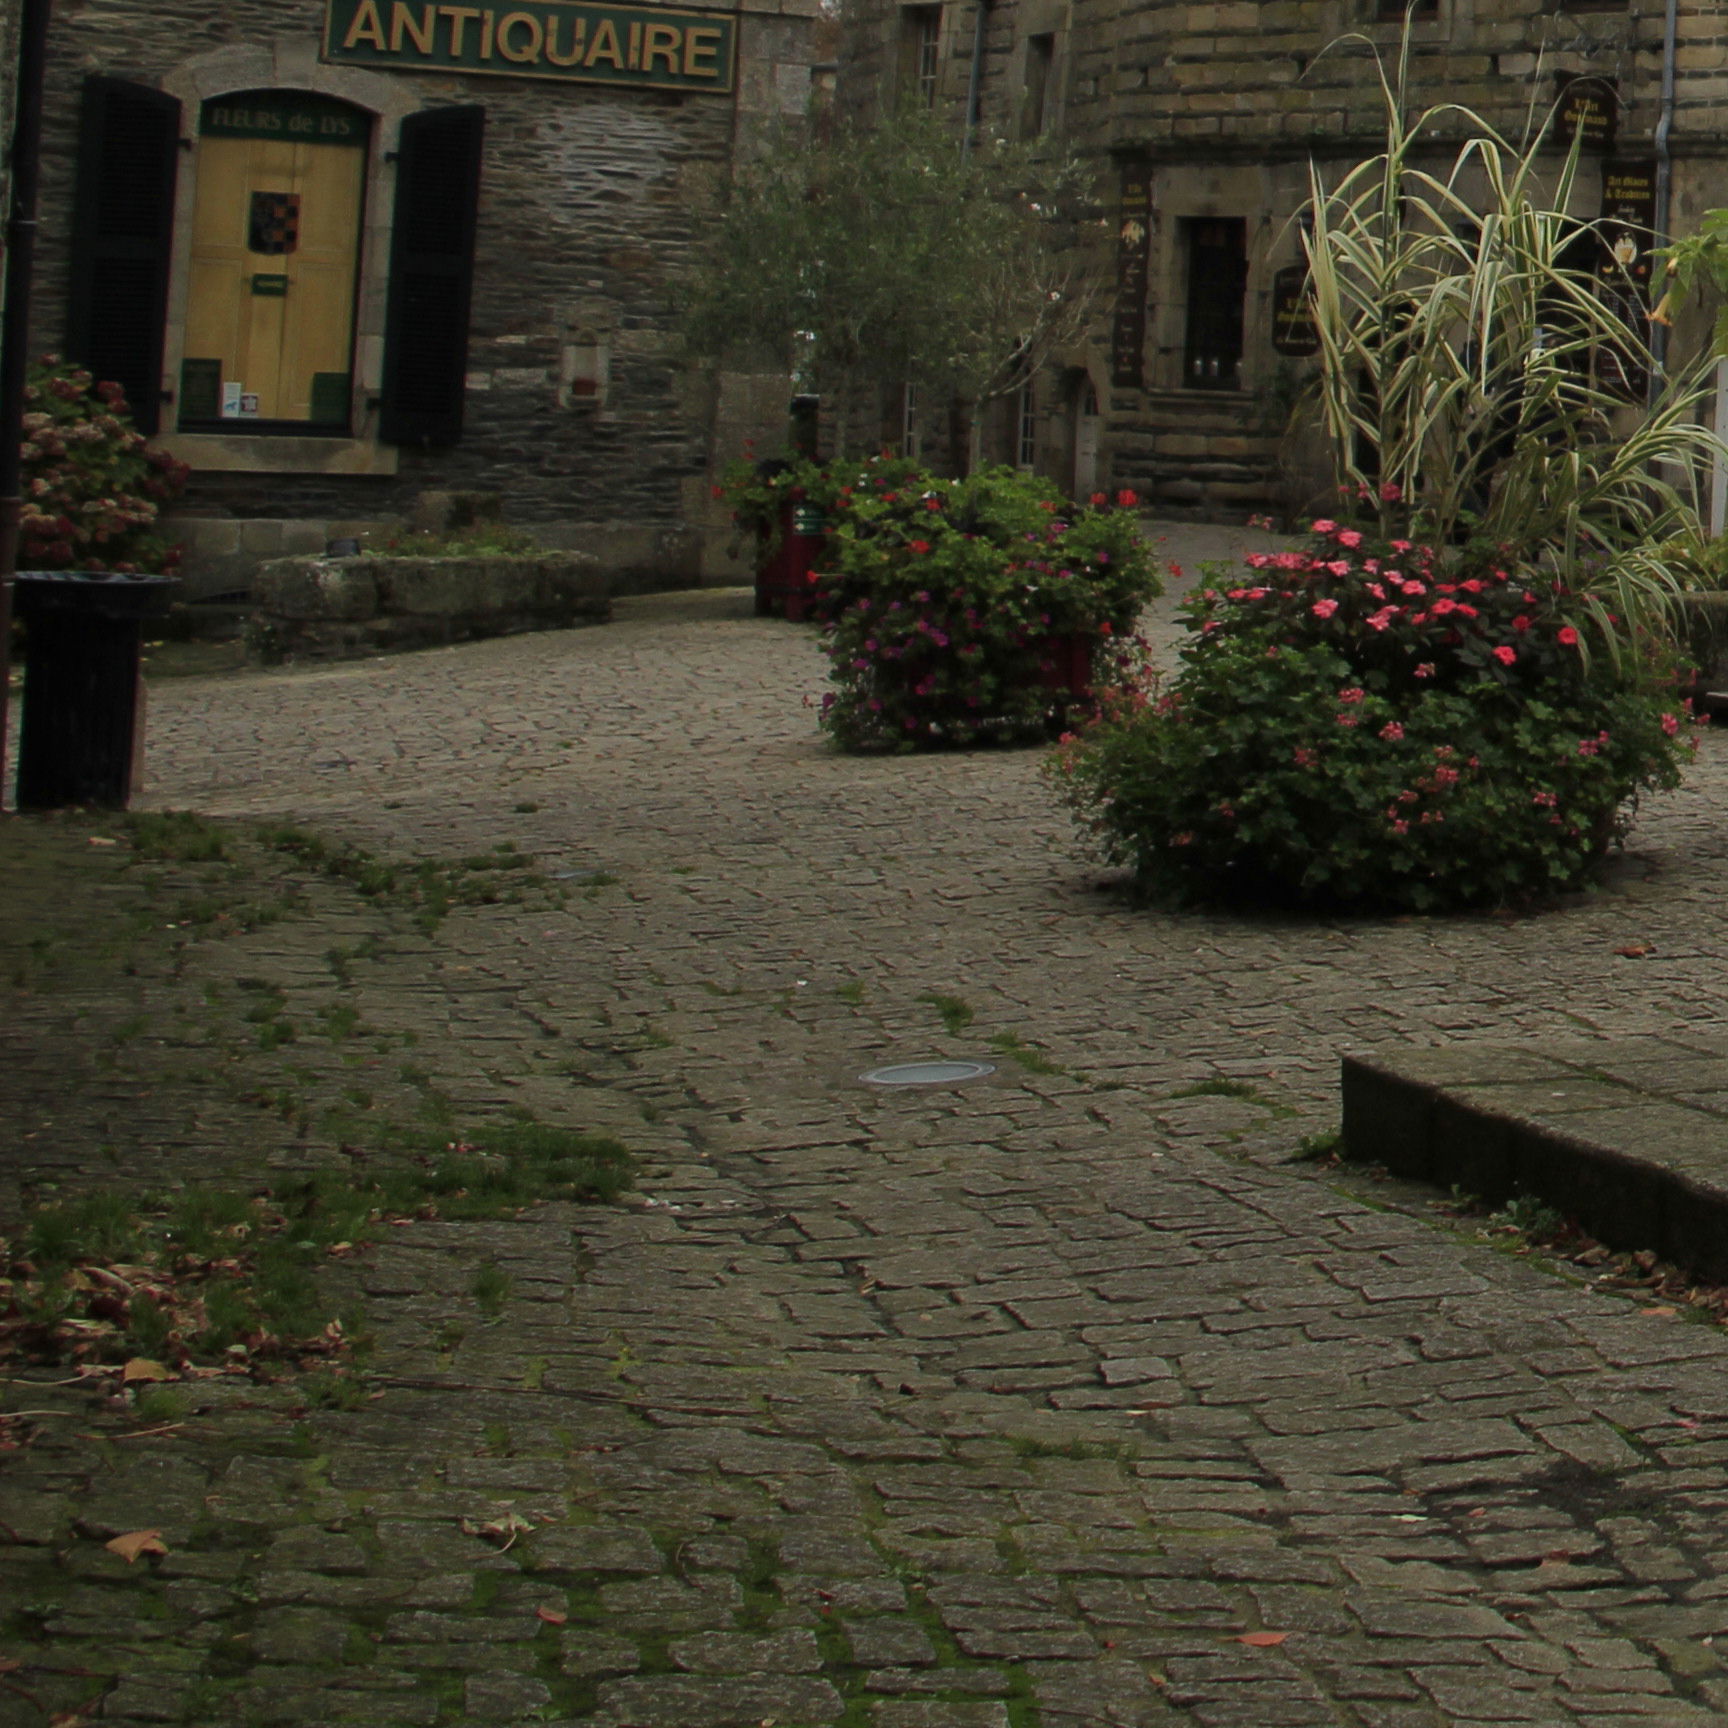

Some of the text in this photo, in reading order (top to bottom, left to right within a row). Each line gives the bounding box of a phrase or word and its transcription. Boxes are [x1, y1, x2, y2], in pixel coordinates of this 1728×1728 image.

[342, 0, 723, 78] ANTIQUAIRE
[211, 106, 352, 136] FLEURS de LYS
